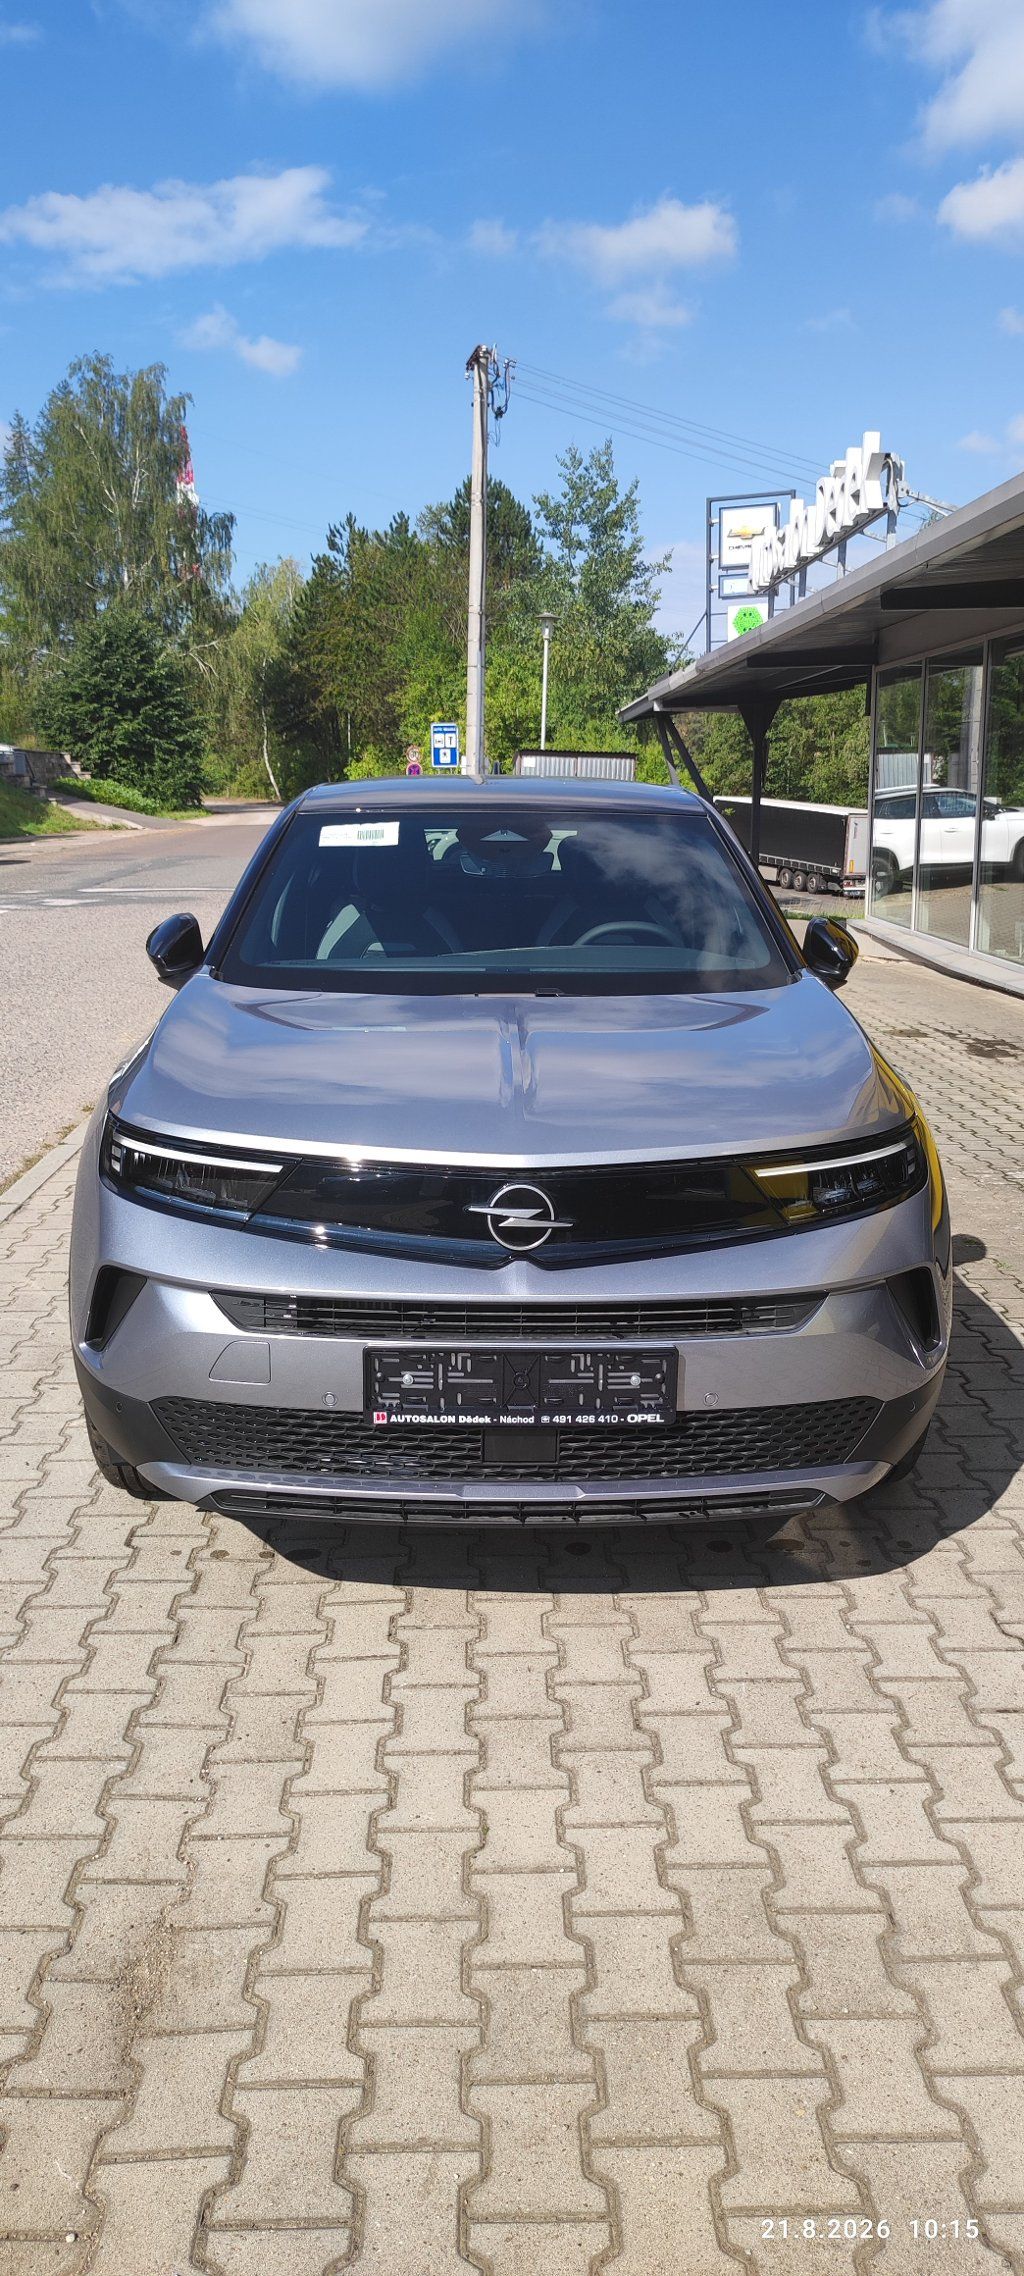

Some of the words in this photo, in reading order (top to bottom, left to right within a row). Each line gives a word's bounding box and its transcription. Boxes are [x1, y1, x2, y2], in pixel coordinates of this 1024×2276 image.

[390, 1414, 456, 1424] AUTOSALON
[459, 1414, 492, 1424] Dědek
[499, 1414, 535, 1424] Náchod
[552, 1414, 572, 1424] 491
[575, 1414, 596, 1424] 426
[597, 1414, 619, 1424] 410
[626, 1413, 665, 1424] OPEL
